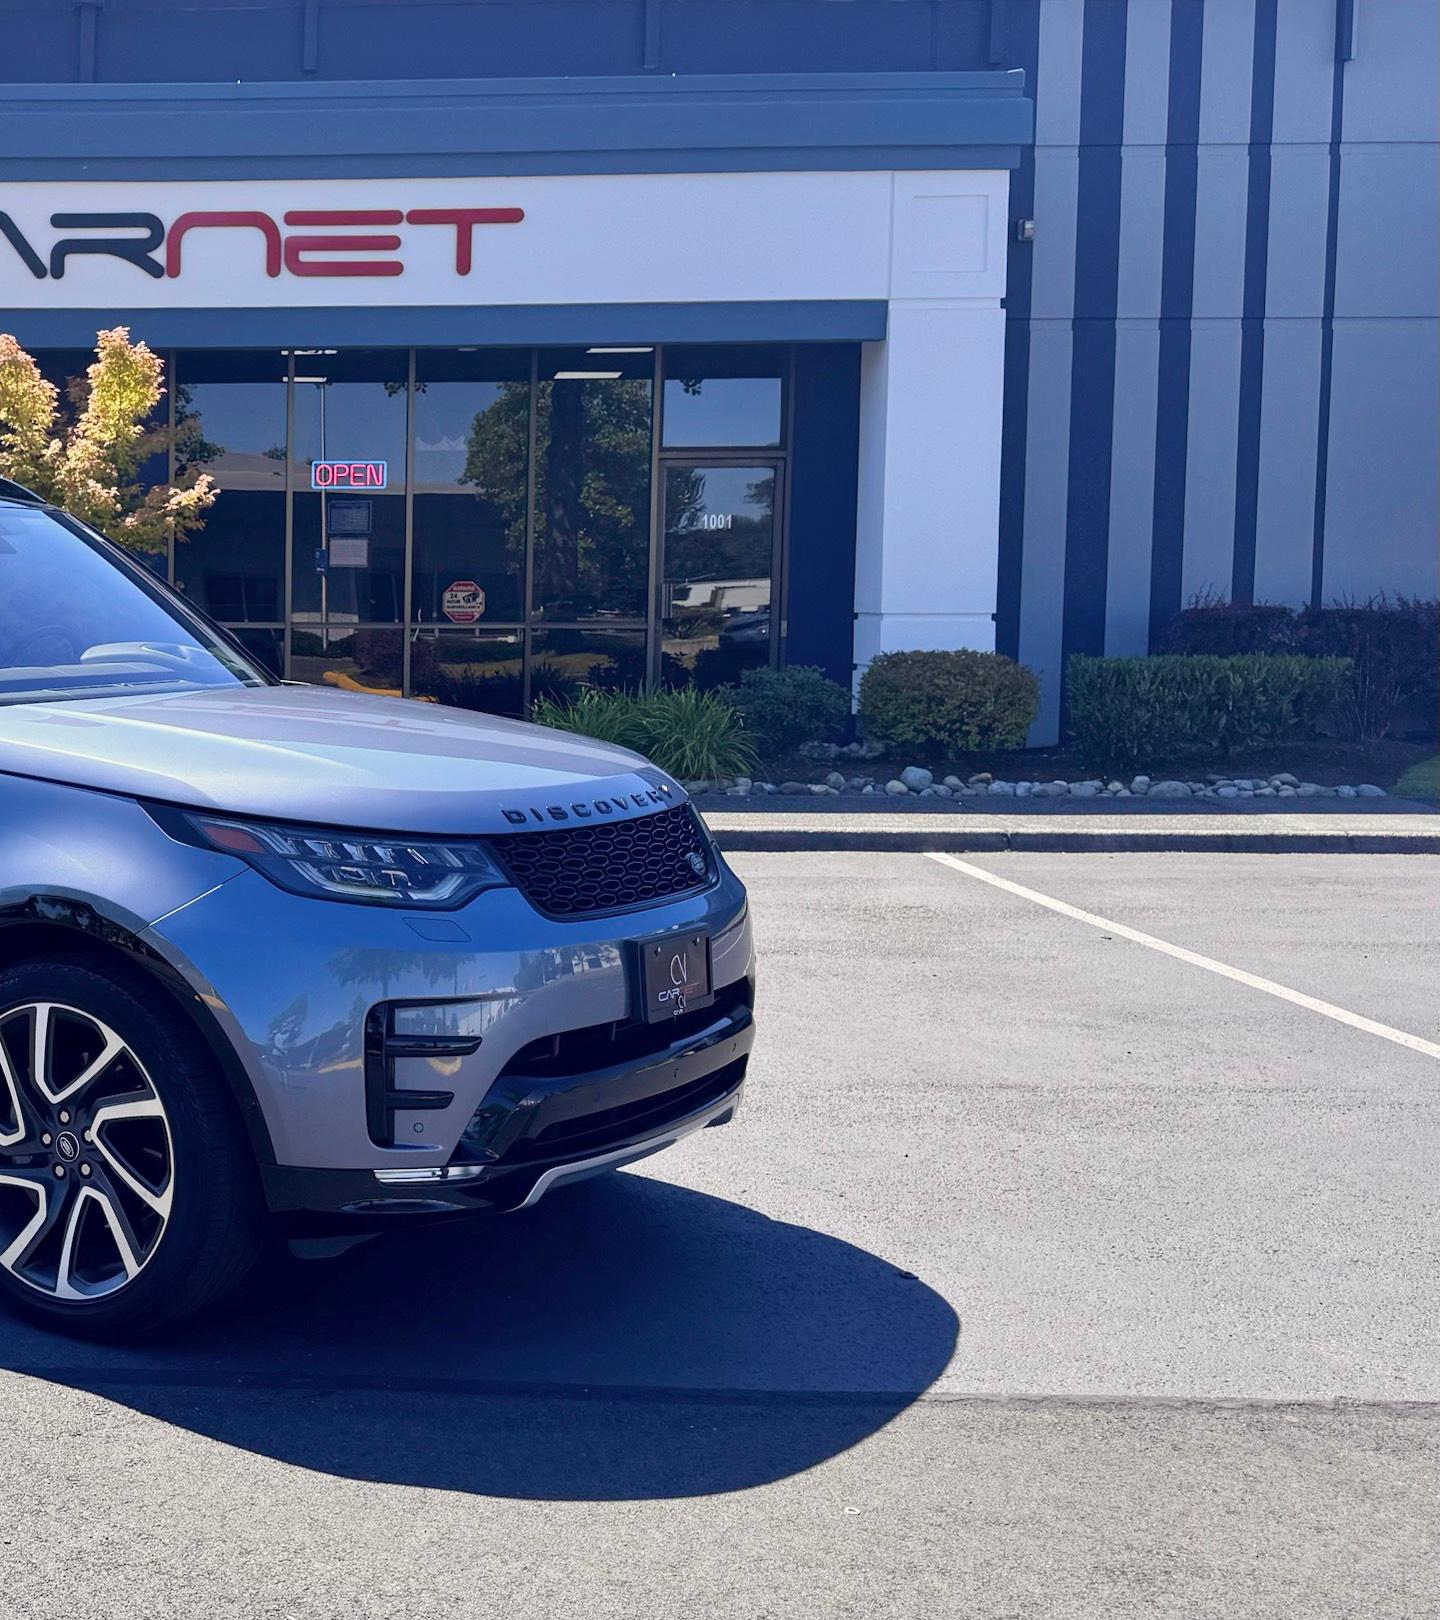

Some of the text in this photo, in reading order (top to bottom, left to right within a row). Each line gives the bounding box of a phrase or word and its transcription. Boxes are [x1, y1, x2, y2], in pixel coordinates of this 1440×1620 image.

[316, 464, 383, 486] OPEN
[703, 513, 733, 529] 1001
[501, 784, 672, 824] DISCOVERY
